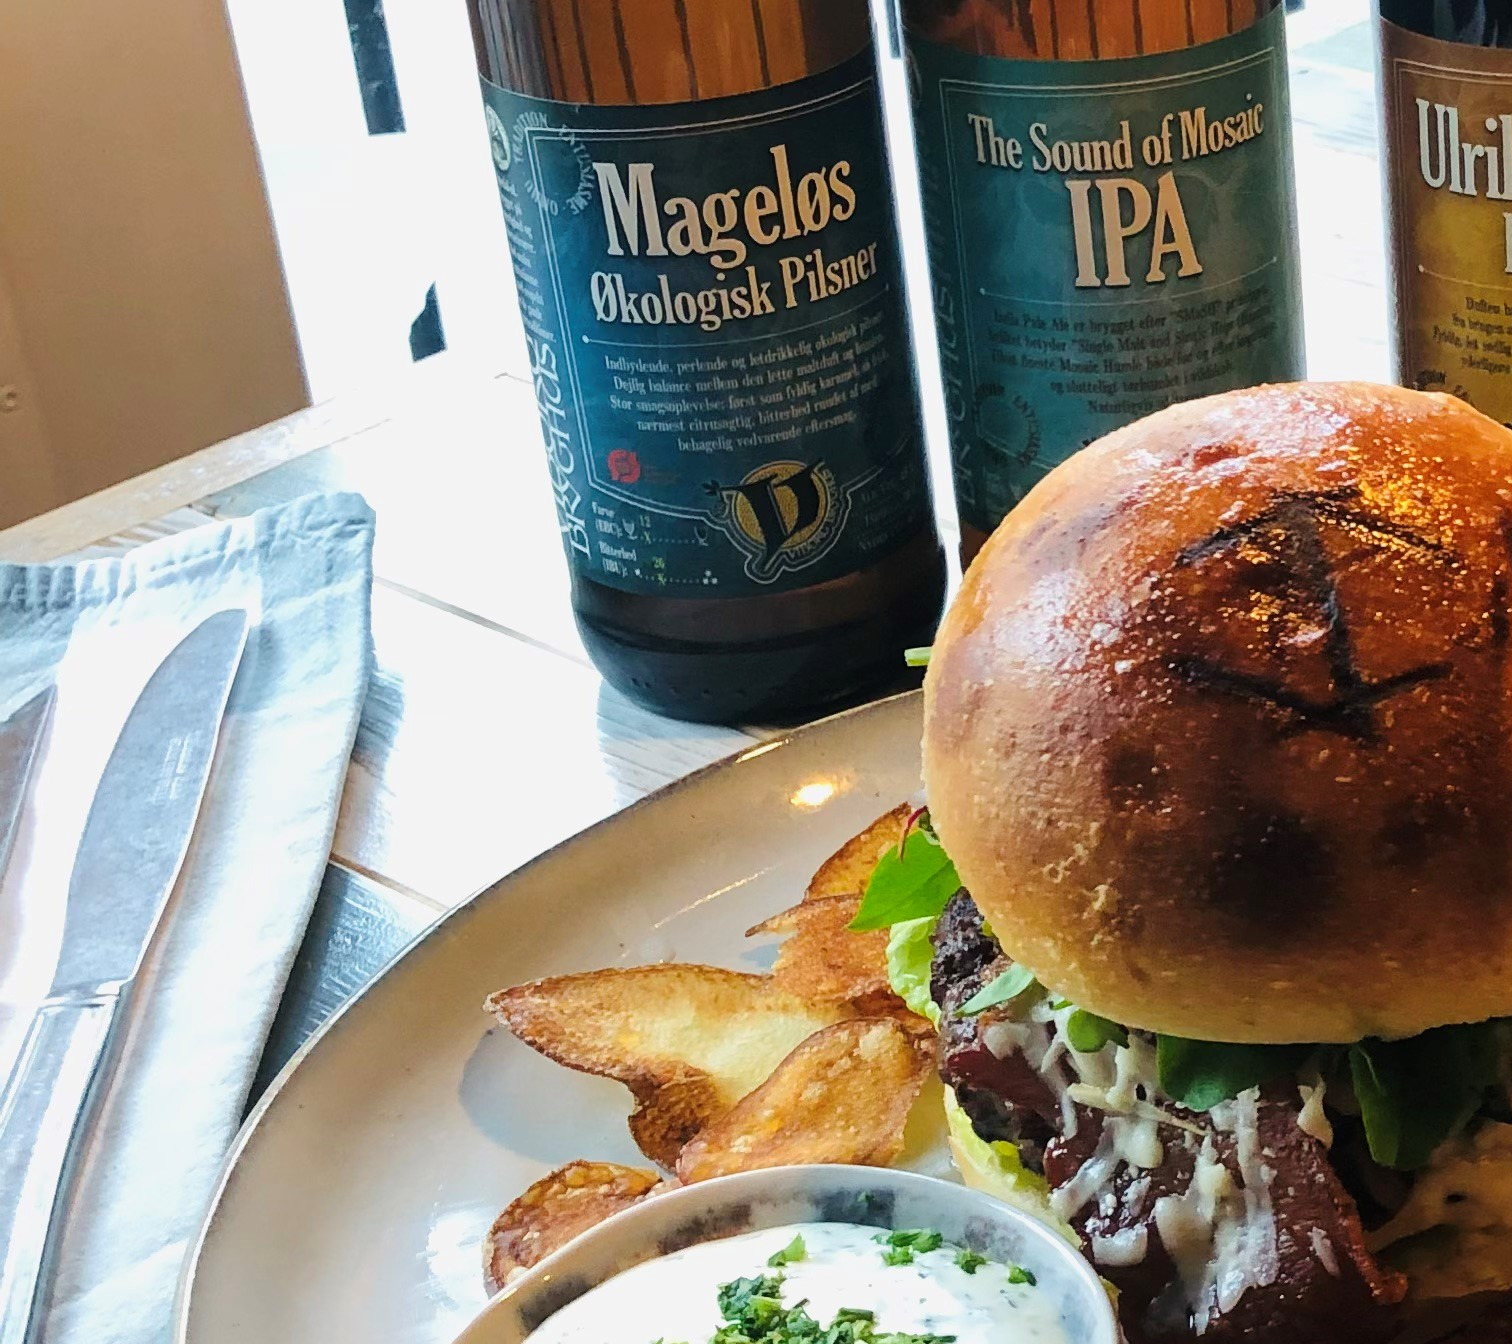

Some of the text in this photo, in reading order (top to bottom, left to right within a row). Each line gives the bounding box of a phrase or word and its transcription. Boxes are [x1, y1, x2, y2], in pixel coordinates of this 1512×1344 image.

[967, 92, 1266, 172] The Sound of Mosaic
[593, 144, 857, 270] Mageløs
[1065, 170, 1203, 289] IPA
[590, 241, 878, 332] Økologisk Pilsner
[605, 355, 674, 375] Indbydende,
[732, 357, 747, 369] og
[614, 376, 646, 395] Dejlig
[648, 378, 692, 393] balance
[695, 375, 739, 392] mellem
[742, 374, 764, 387] den
[767, 369, 794, 384] lette
[609, 394, 633, 410] Stor
[760, 390, 783, 404] som
[637, 420, 686, 432] nærmest
[758, 400, 811, 425] bitterhed
[678, 436, 734, 454] behagelig
[736, 424, 803, 447] vedvarende
